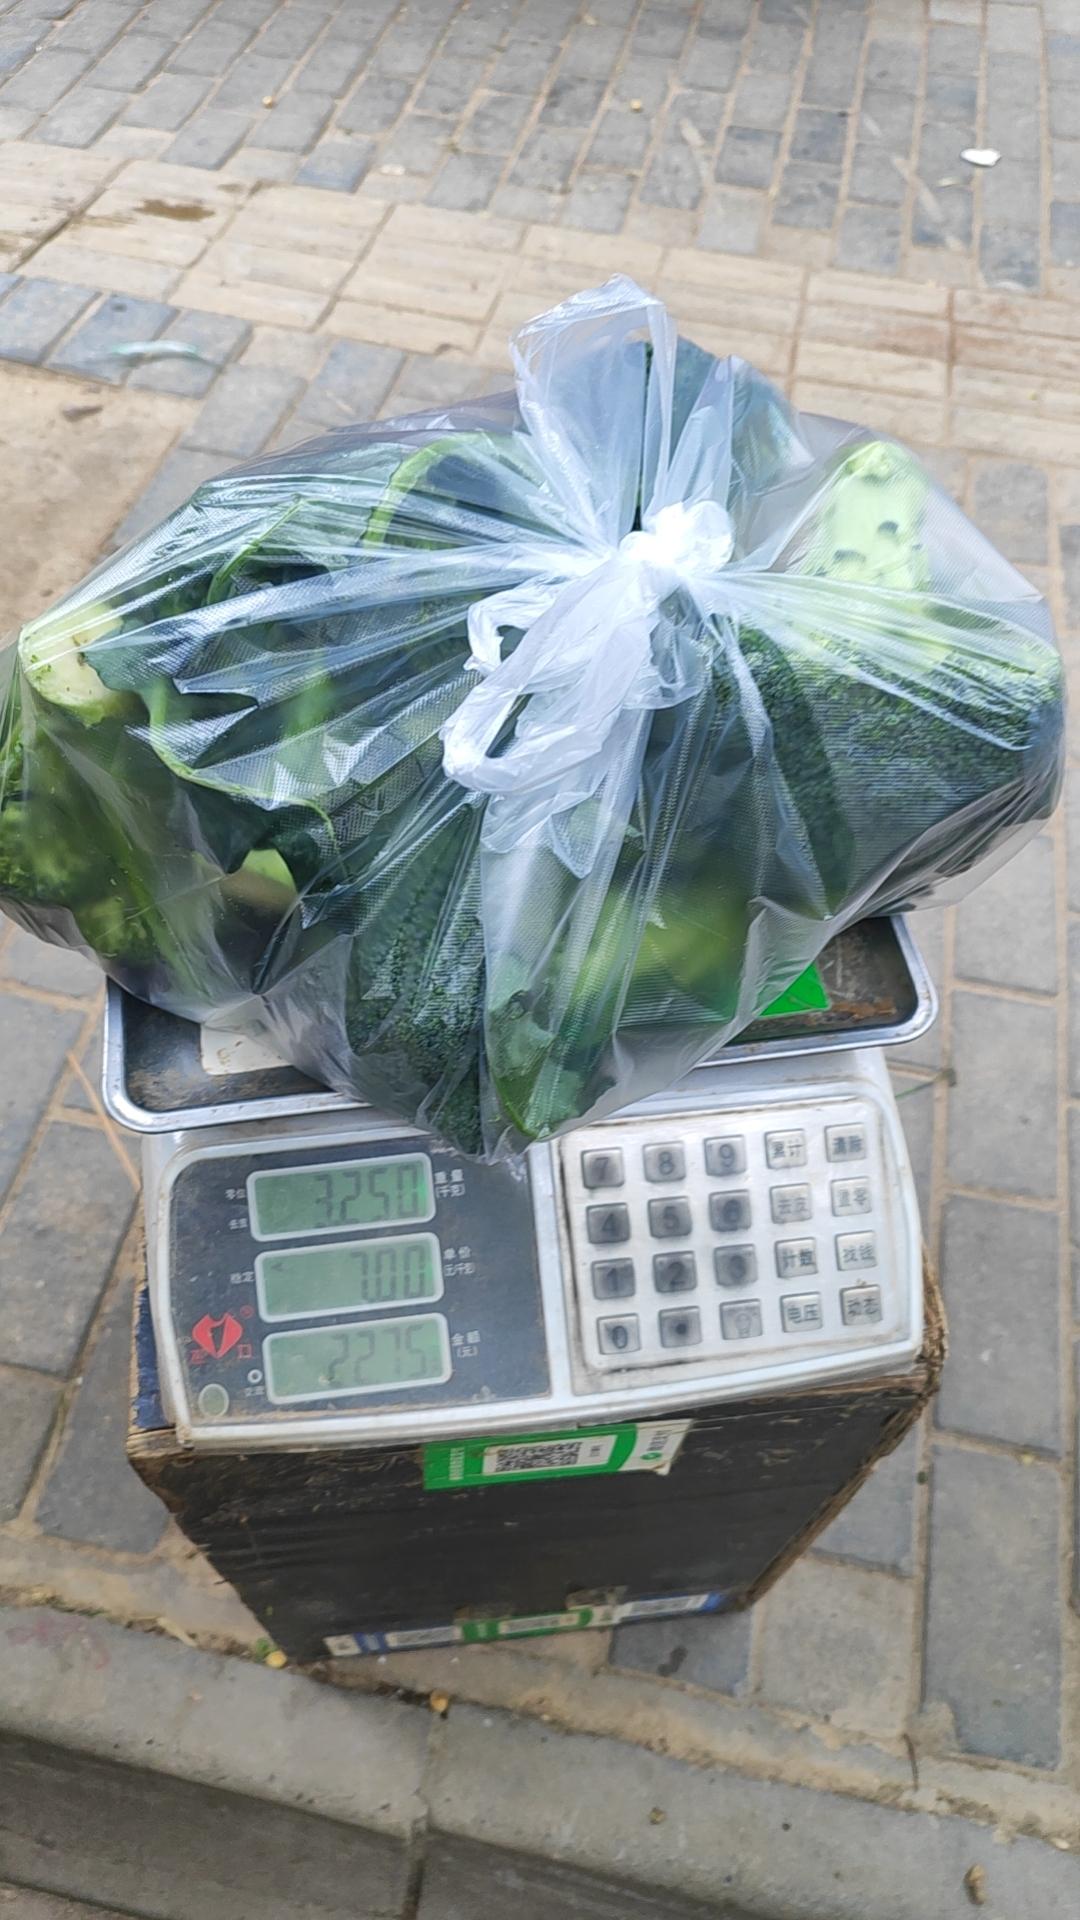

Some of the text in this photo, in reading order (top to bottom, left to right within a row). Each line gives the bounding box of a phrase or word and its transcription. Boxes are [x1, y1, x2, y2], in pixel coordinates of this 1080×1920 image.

[718, 1143, 736, 1168] 9
[772, 1138, 804, 1158] 累计
[592, 1156, 610, 1181] 7
[658, 1151, 675, 1176] 8
[602, 1213, 618, 1238] 4
[663, 1205, 681, 1231] 5
[606, 1267, 618, 1292] 1
[667, 1261, 686, 1287] 2
[787, 1303, 821, 1324] 电压
[611, 1325, 629, 1349] 0
